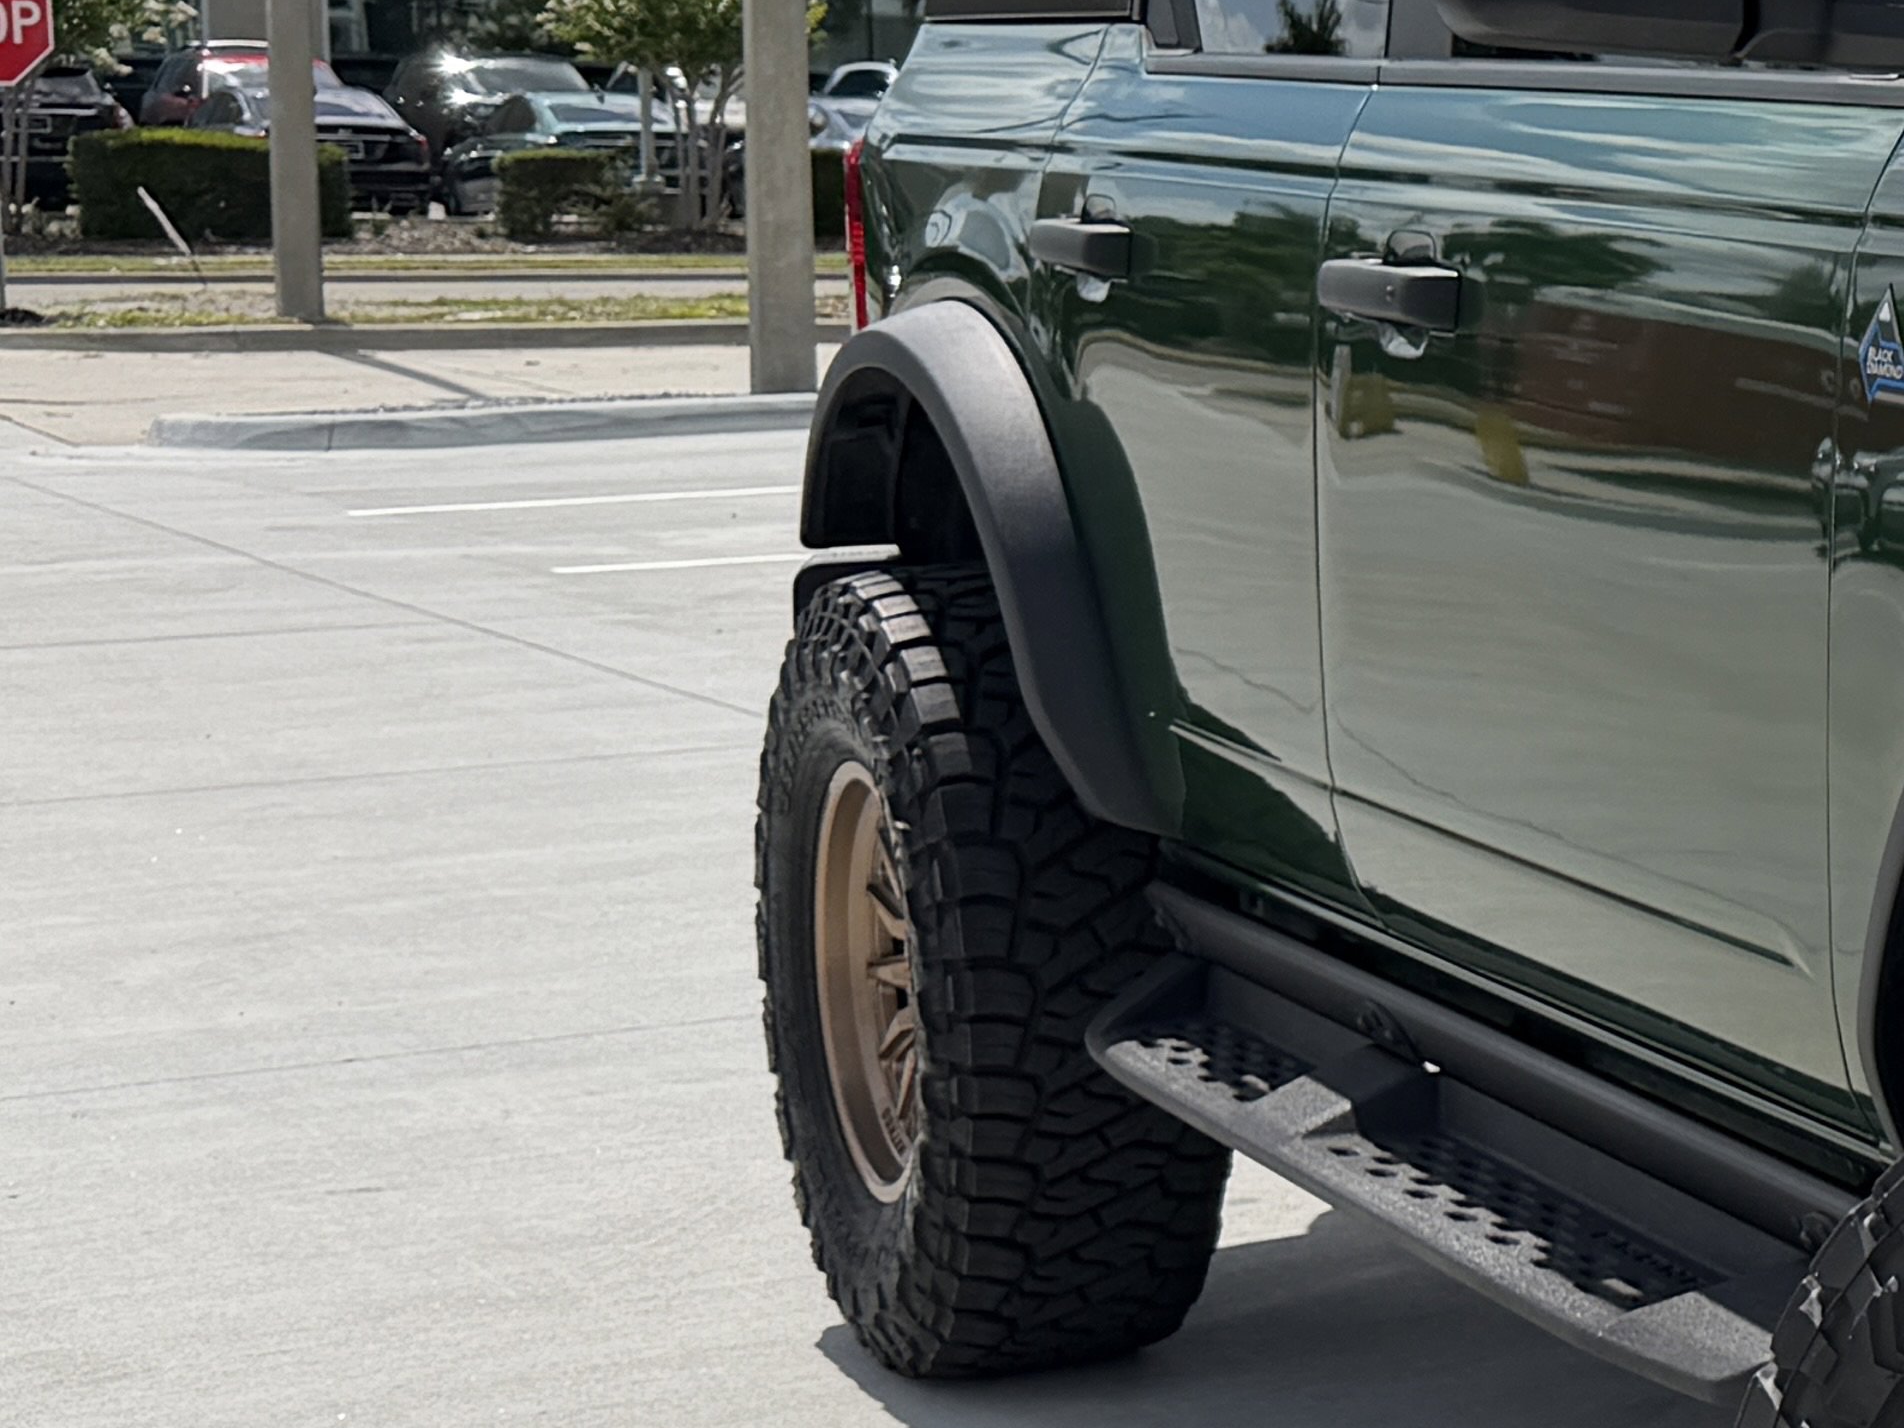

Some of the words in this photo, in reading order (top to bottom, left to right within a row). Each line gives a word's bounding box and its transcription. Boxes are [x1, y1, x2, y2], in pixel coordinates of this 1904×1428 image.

[0, 0, 42, 44] P
[1868, 346, 1894, 362] BLACK
[1866, 361, 1904, 380] DIAMOND
